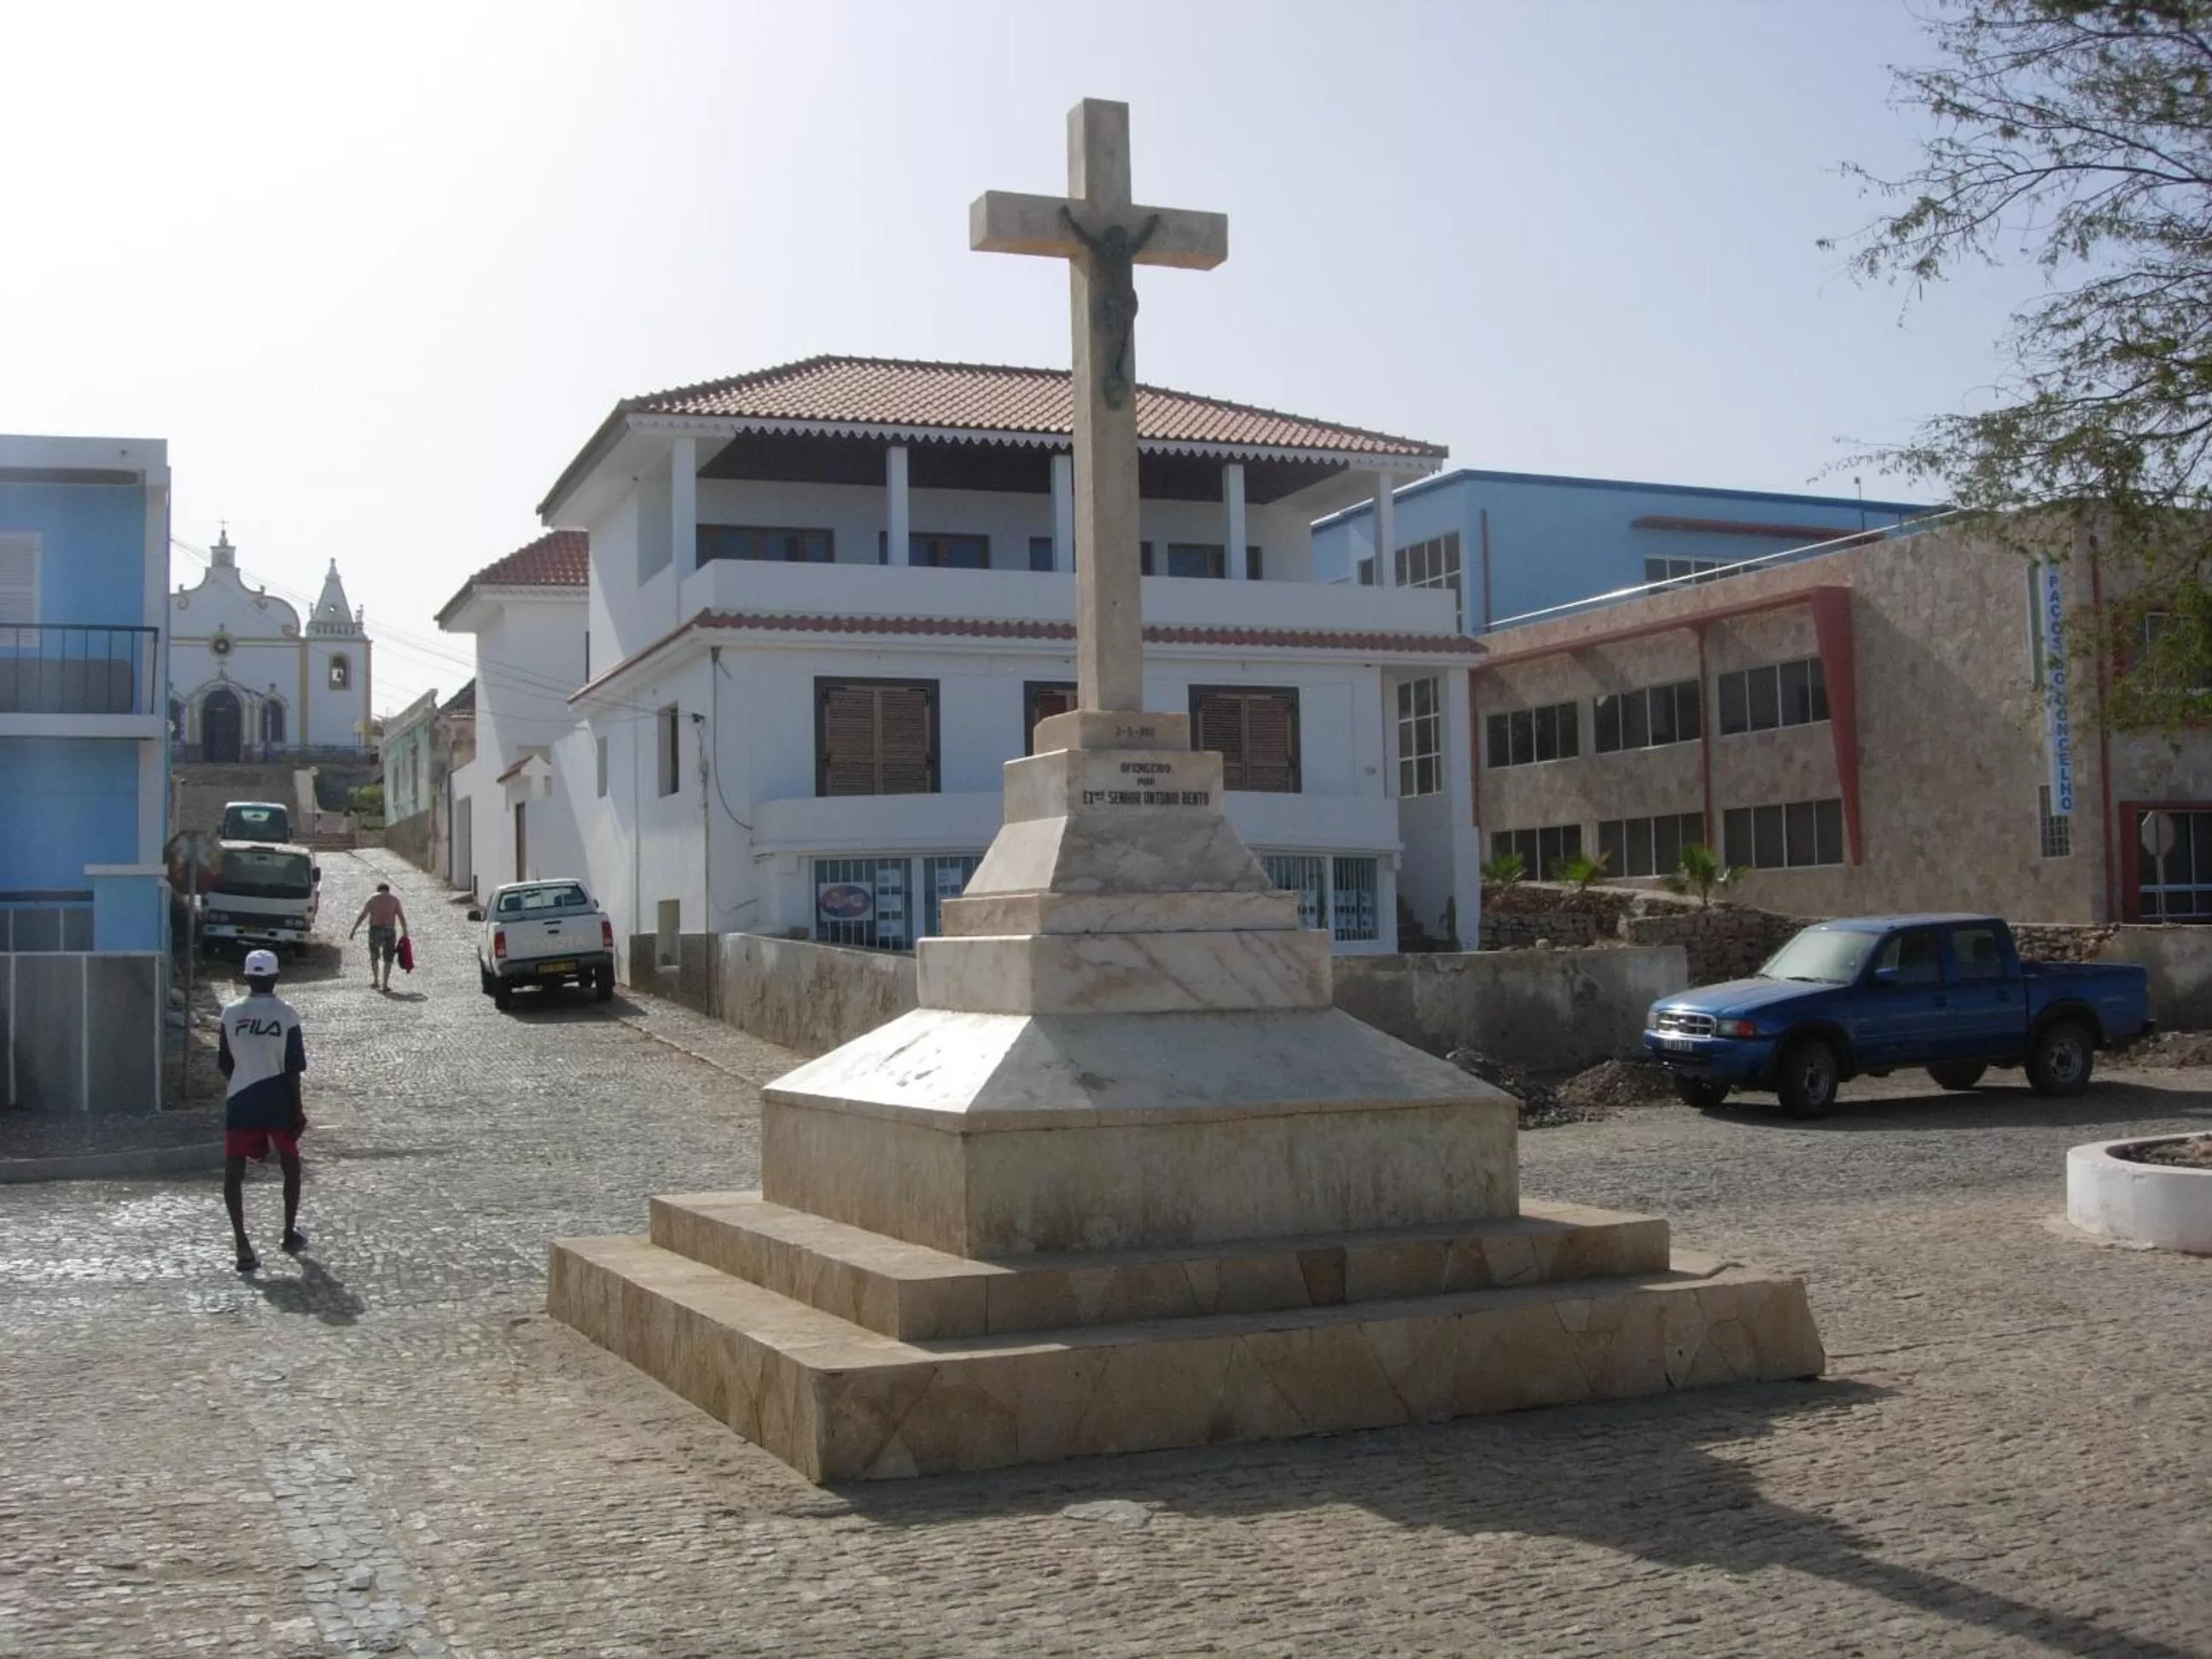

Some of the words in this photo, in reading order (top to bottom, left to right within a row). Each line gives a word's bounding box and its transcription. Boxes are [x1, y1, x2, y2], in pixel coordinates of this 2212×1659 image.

[1109, 790, 1141, 805] SENHOR
[1182, 791, 1209, 806] BENTO
[236, 1018, 282, 1037] FILA
